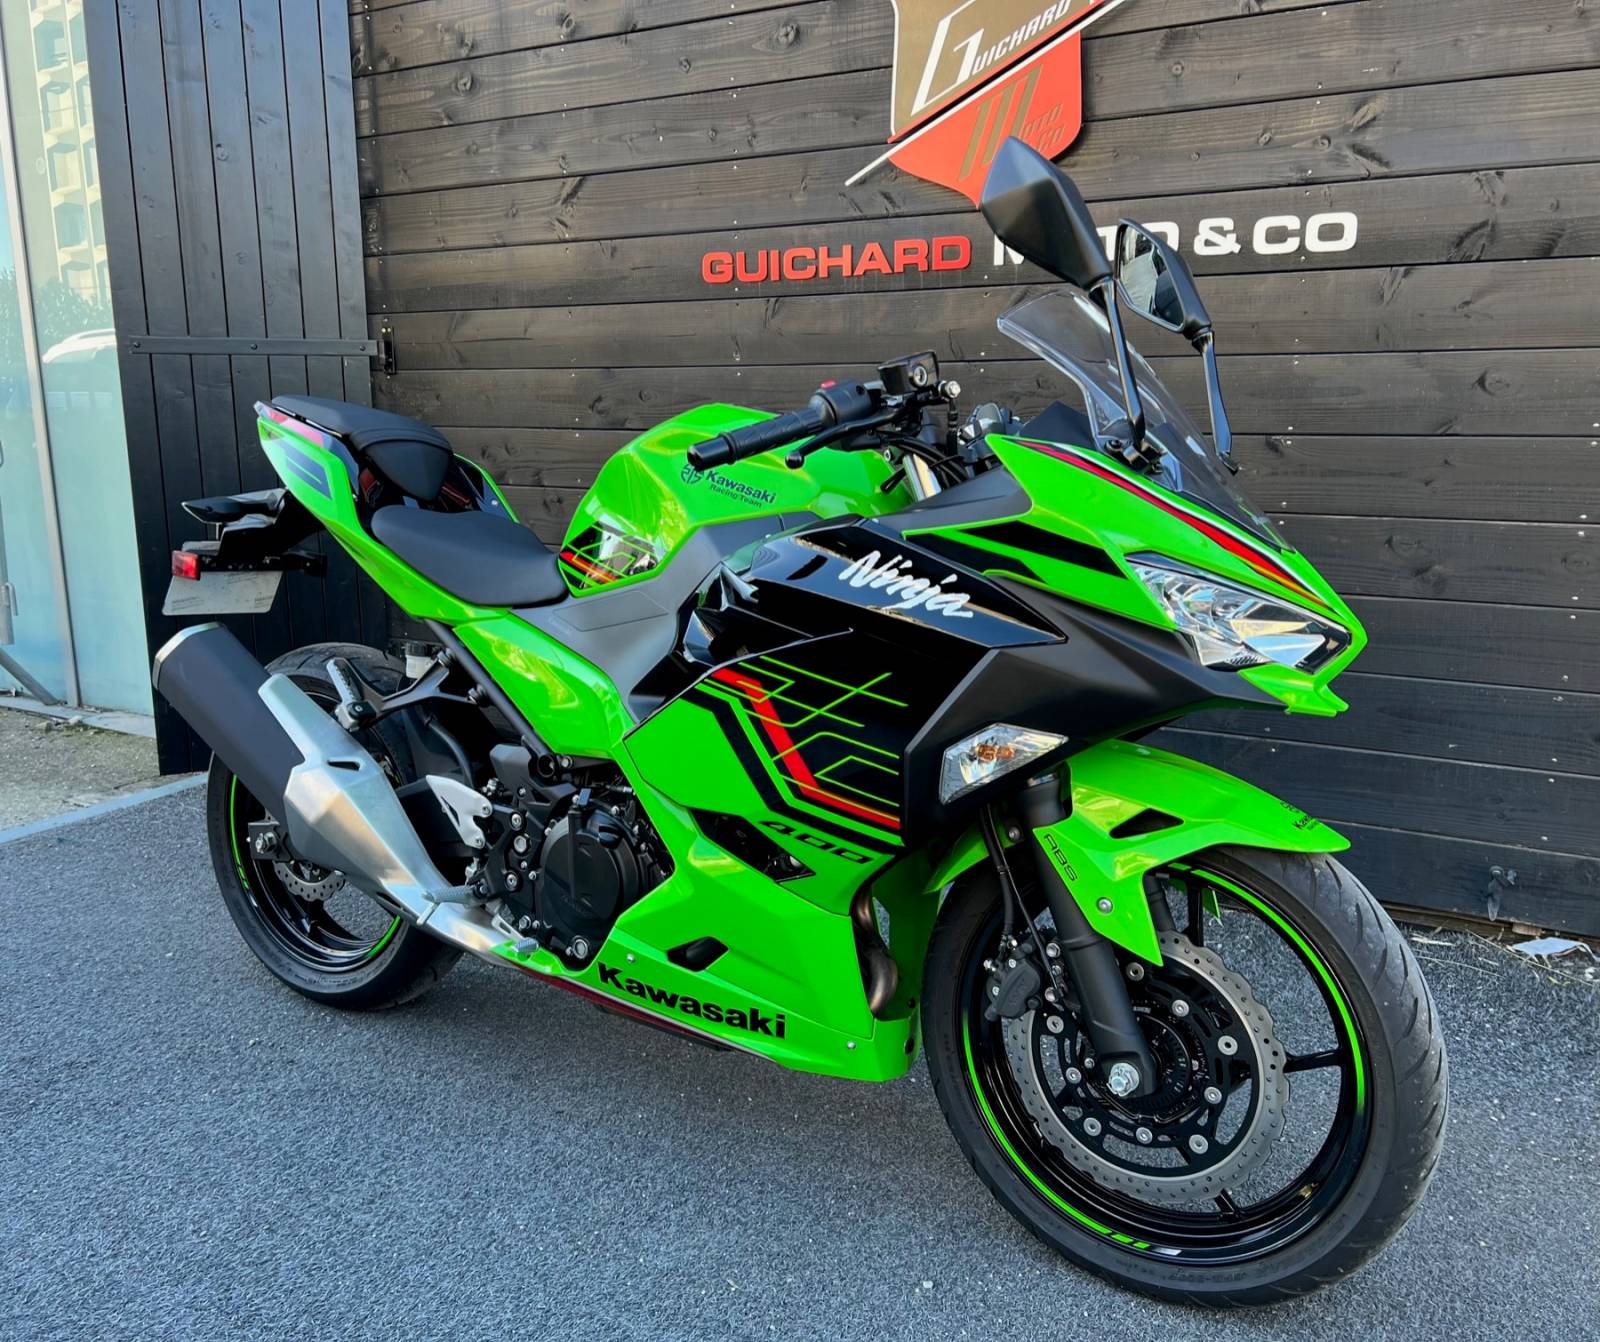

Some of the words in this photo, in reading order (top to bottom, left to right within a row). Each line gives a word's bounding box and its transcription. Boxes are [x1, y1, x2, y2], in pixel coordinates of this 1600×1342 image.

[701, 235, 972, 284] GUICHARD
[705, 470, 777, 504] Kawasaki
[710, 484, 738, 500] Racing
[739, 495, 763, 508] Team
[838, 550, 974, 619] Ninja
[758, 820, 876, 865] 400
[1043, 833, 1078, 882] ABS
[597, 962, 787, 1040] Kawasaki
